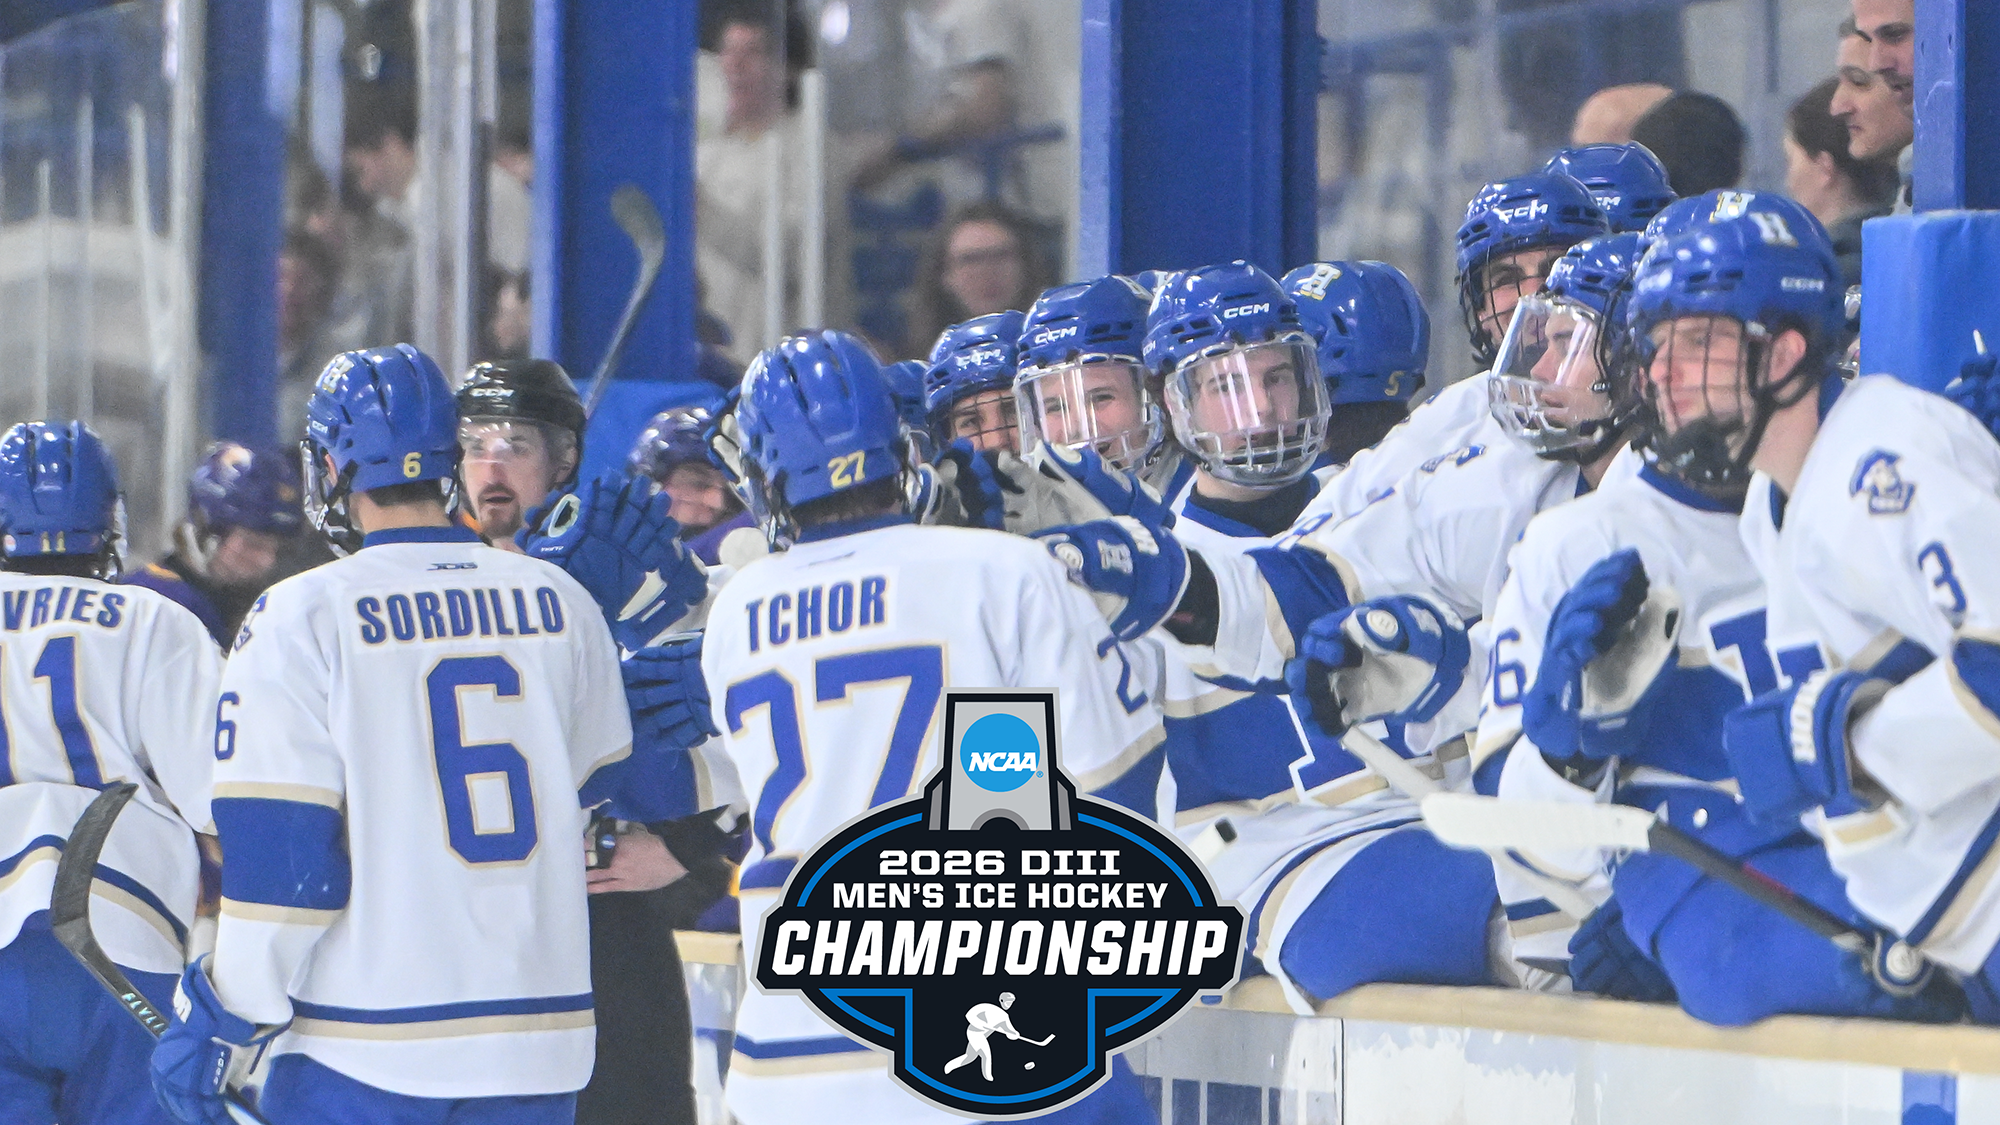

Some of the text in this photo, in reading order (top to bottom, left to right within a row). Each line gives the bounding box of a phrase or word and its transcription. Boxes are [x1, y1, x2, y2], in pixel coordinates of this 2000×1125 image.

[1223, 302, 1270, 319] CCM
[1034, 325, 1078, 346] CCM
[468, 387, 515, 397] CCM
[403, 452, 422, 479] 6
[827, 449, 865, 489] 27
[41, 530, 67, 553] 11
[2, 586, 126, 631] VRIES
[355, 586, 566, 645] SORDILLO
[745, 575, 887, 653] TCHOR
[214, 691, 240, 761] 6
[424, 653, 541, 867] 6
[723, 642, 945, 855] 27
